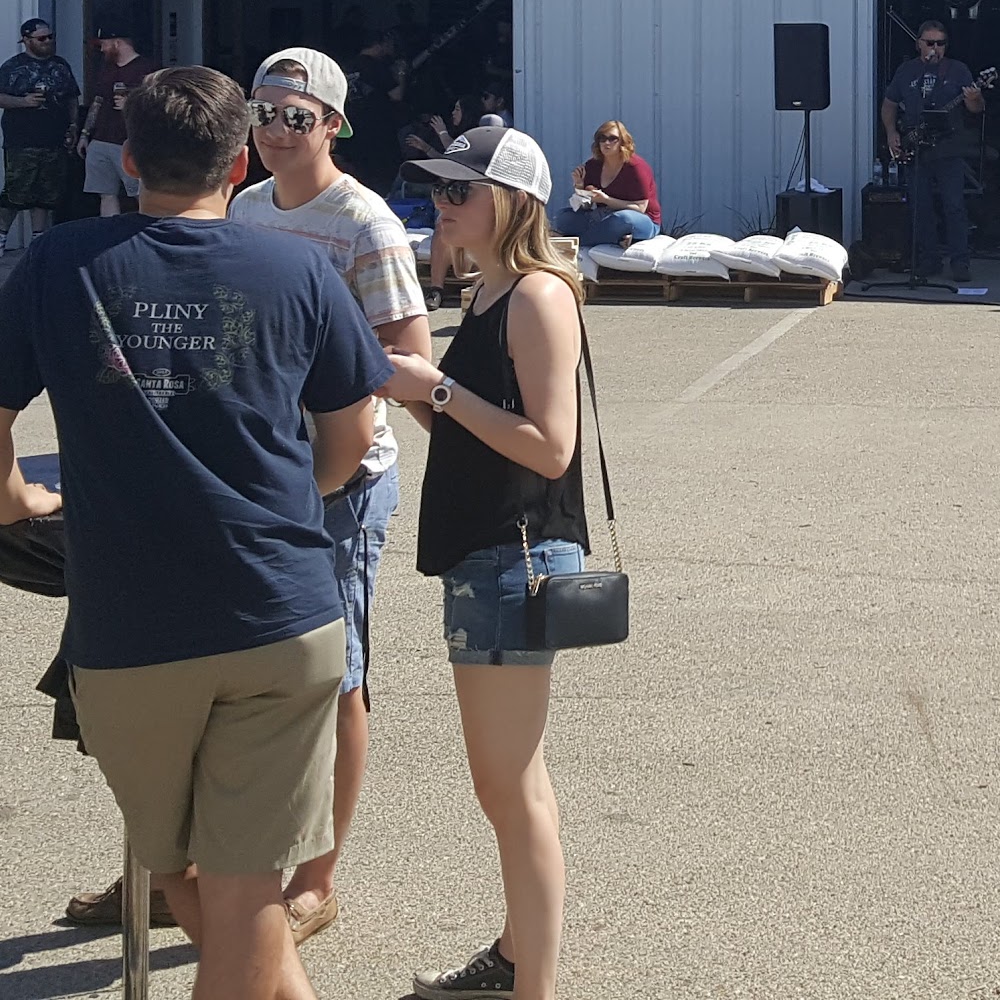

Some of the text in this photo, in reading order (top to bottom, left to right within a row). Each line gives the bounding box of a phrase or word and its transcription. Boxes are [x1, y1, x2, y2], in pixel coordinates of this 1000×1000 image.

[133, 302, 209, 320] PLINY
[151, 323, 183, 333] THE
[116, 334, 216, 350] YOUNGER
[163, 378, 185, 389] ROSA
